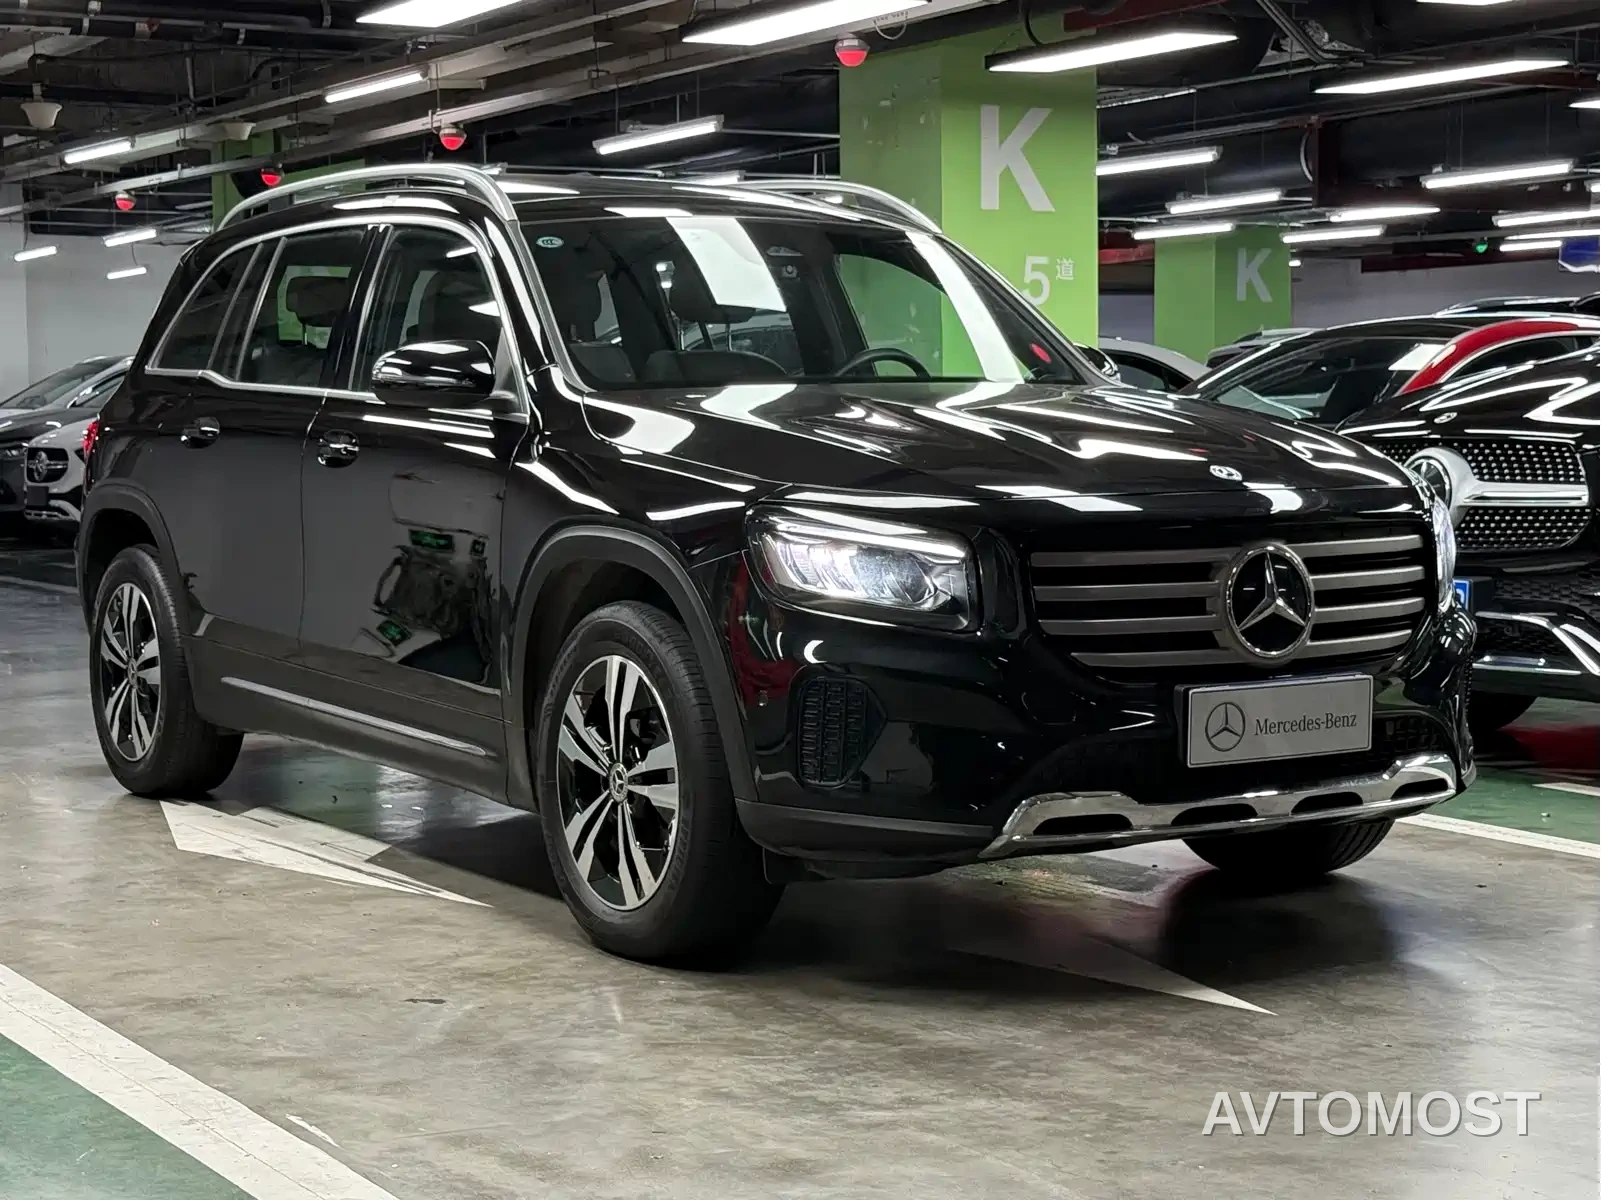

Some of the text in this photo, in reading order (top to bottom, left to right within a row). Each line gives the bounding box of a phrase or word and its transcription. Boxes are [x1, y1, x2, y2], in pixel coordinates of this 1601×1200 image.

[980, 104, 1055, 212] K
[1021, 254, 1075, 306] 5 道
[1237, 247, 1273, 303] K
[1254, 712, 1357, 736] Mercedes-Benz
